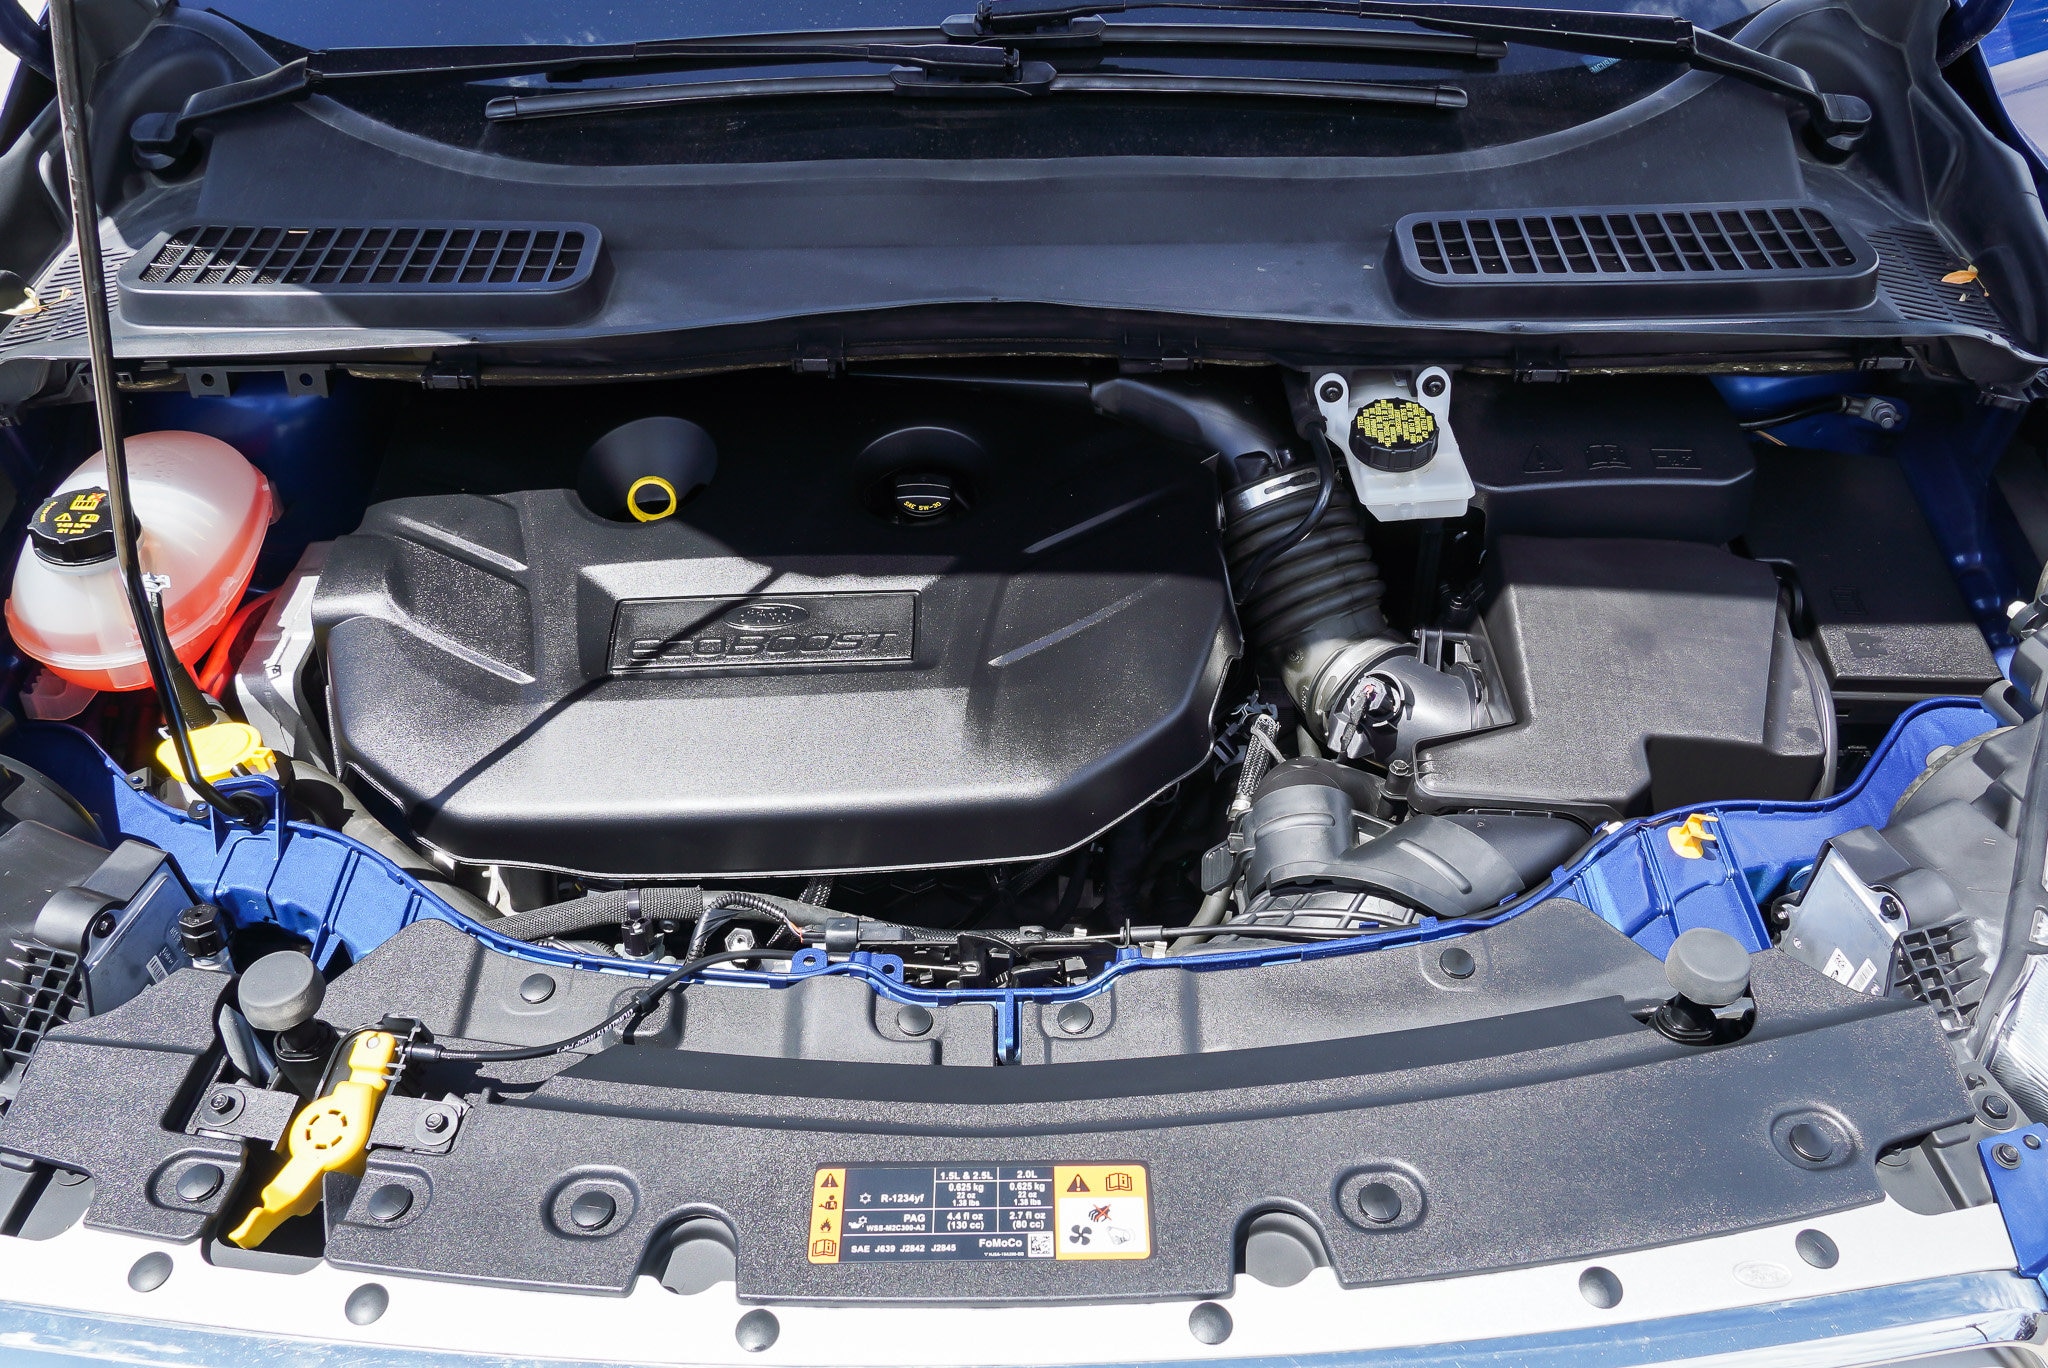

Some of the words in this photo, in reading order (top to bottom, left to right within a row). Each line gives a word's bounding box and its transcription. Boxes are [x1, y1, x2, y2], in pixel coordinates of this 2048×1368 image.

[904, 501, 916, 509] SAE
[918, 502, 941, 510] 5W-30
[940, 1172, 960, 1180] 1.5L
[963, 1172, 970, 1180] &
[973, 1171, 993, 1180] 2.5L
[1017, 1170, 1037, 1178] 2.0L
[948, 1183, 971, 1192] 0.625
[973, 1183, 984, 1193] kg
[1009, 1182, 1032, 1191] 0.625
[1034, 1182, 1045, 1192] kg
[881, 1194, 924, 1204] R-1234yf
[903, 1214, 926, 1222] PAG
[947, 1212, 961, 1220] 4.4
[963, 1212, 969, 1220] fl
[1009, 1212, 1023, 1220] 2.7
[1025, 1211, 1032, 1219] fl
[947, 1221, 967, 1231] (130
[969, 1221, 984, 1230] cc)
[1012, 1221, 1027, 1230] (80
[1029, 1220, 1044, 1230] cc)
[979, 1238, 1022, 1247] FoMoCo
[851, 1245, 870, 1253] SAE
[900, 1244, 925, 1252] J2842
[931, 1244, 956, 1252] J2845
